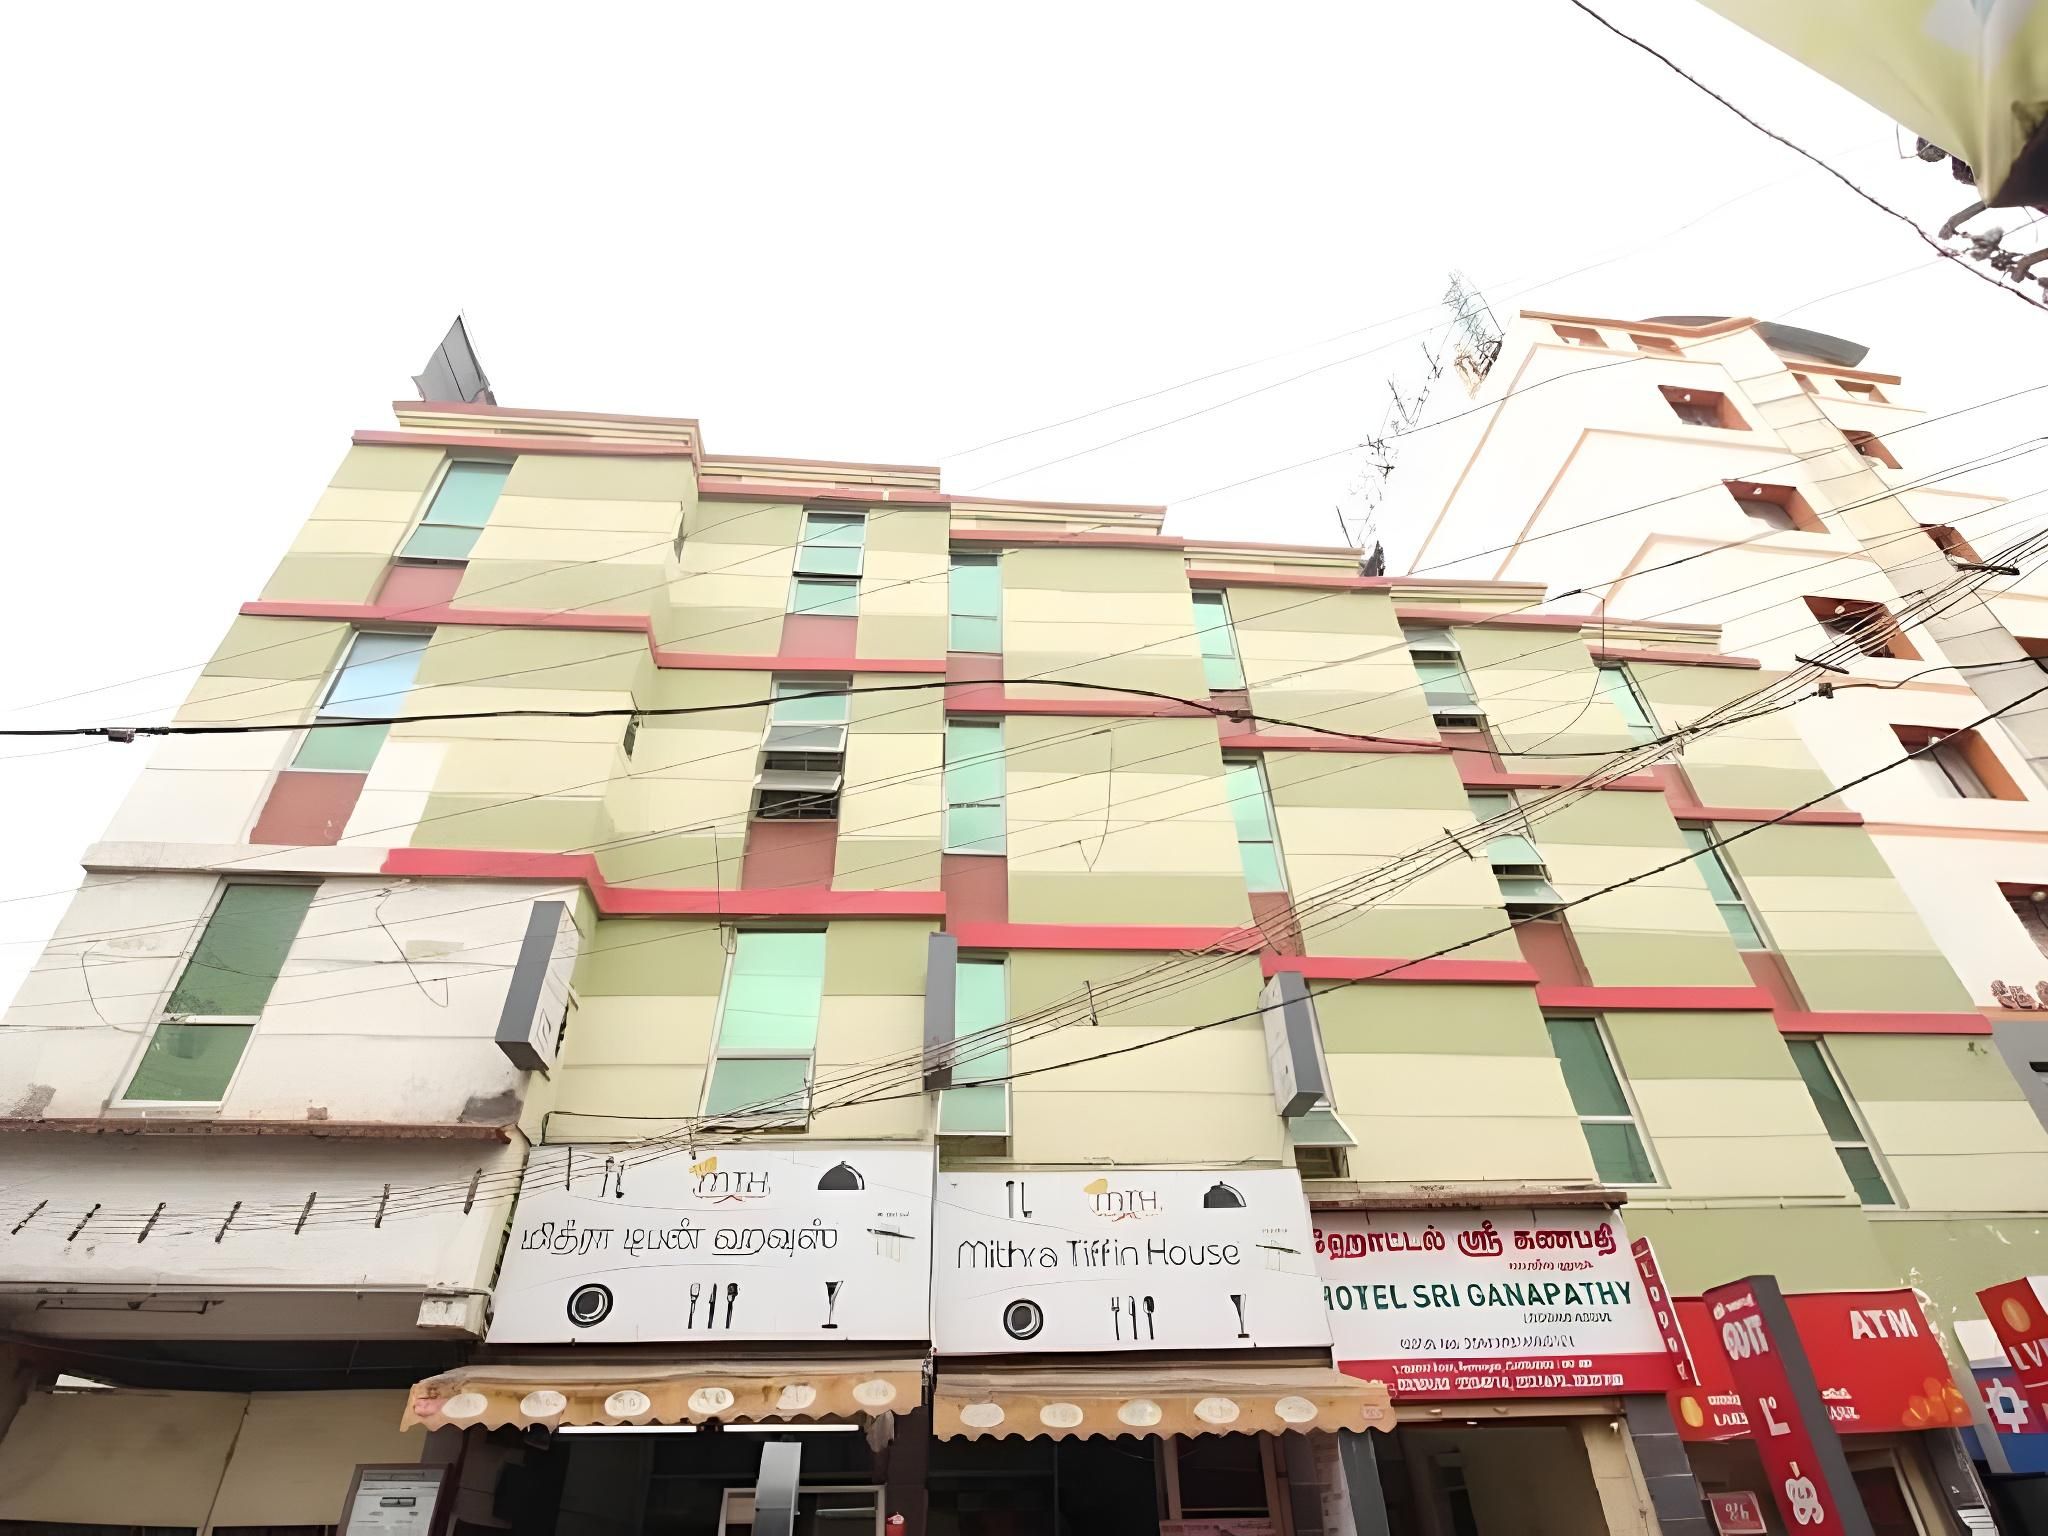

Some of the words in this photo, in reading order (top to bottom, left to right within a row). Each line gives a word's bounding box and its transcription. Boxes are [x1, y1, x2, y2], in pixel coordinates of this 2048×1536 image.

[521, 1219, 615, 1256] மித்ரா
[623, 1217, 706, 1258] டிபன்
[712, 1218, 838, 1258] ஹவுஸ்
[957, 1239, 1058, 1268] Mithra
[1065, 1238, 1139, 1267] Tiffin
[1147, 1237, 1241, 1266] House
[1513, 1223, 1617, 1257] கணபதி
[1413, 1283, 1461, 1309] SRI
[1467, 1280, 1632, 1308] GANAPATHY
[1849, 1306, 1919, 1341] ATM
